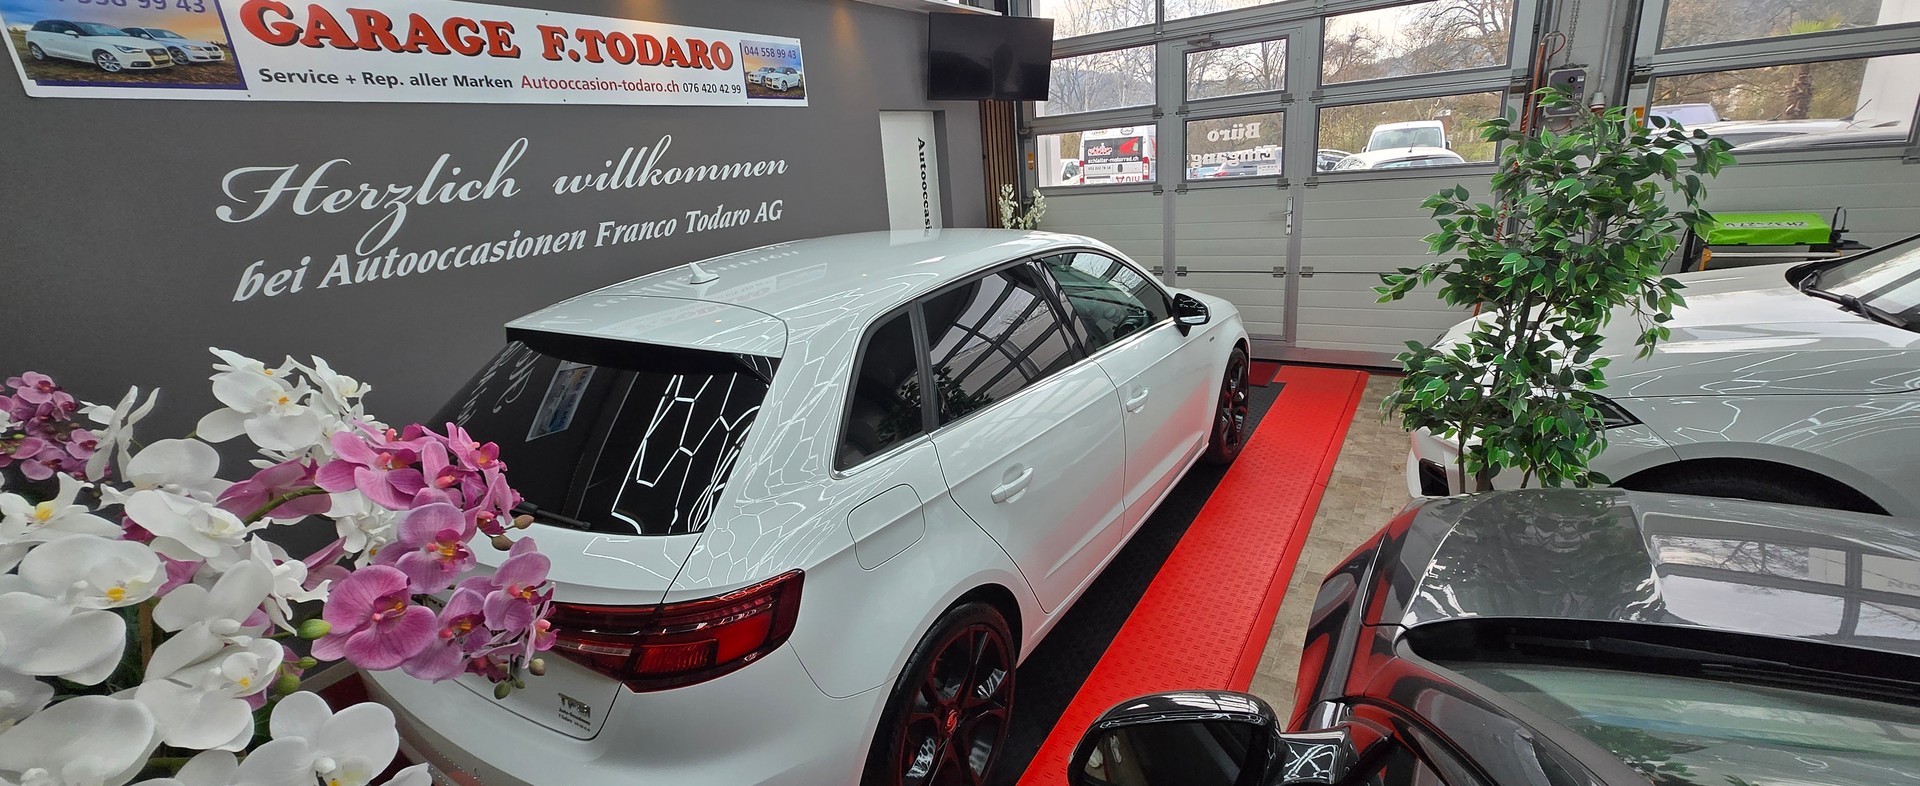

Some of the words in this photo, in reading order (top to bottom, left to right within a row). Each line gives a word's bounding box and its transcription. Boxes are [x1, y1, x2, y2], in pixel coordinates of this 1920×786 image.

[239, 0, 521, 59] GARAGE
[536, 25, 734, 71] F.TODARO
[744, 45, 760, 57] 044
[761, 47, 775, 58] 558
[776, 49, 786, 59] 99
[787, 49, 797, 60] 43
[259, 68, 339, 85] Service
[346, 75, 357, 86] +
[362, 71, 404, 89] Rep.
[410, 73, 448, 87] aller
[453, 74, 513, 88] Marken
[521, 75, 680, 93] Autooccasion-todaro.ch
[683, 82, 699, 93] 076
[701, 83, 718, 94] 420
[719, 83, 730, 94] 42
[732, 84, 742, 94] 99
[215, 137, 528, 256] Herzlich
[553, 134, 788, 196] willkommen
[231, 255, 312, 303] bei
[316, 228, 586, 289] Autooccasionen
[594, 219, 677, 248] Franco
[684, 205, 750, 233] Todaro
[754, 200, 783, 222] AG
